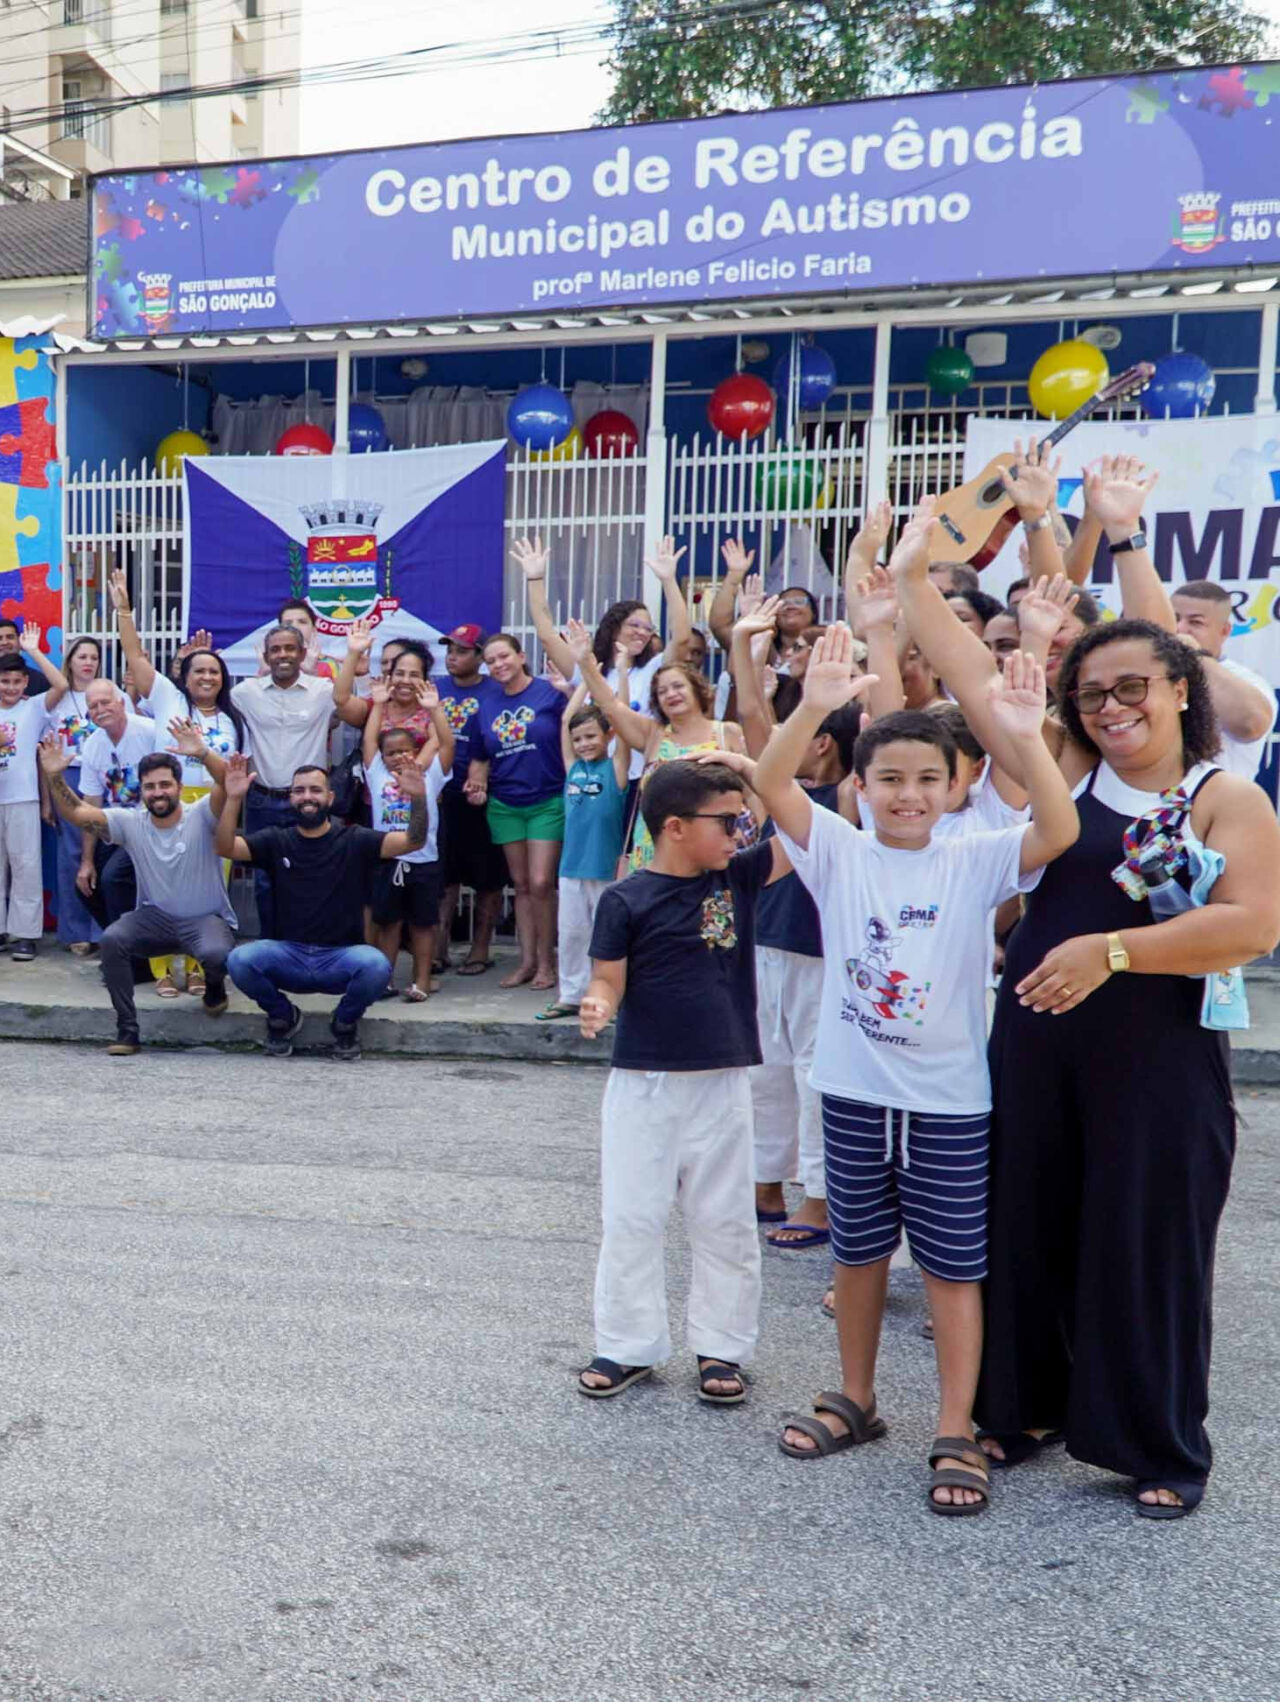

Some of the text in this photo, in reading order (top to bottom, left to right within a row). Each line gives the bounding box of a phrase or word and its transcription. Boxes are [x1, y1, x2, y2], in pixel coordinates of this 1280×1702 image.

[365, 105, 1083, 217] Centro de Referência
[451, 191, 971, 261] Municipal do Autismo
[1231, 217, 1271, 241] SÃO
[179, 275, 277, 293] PREFEITURA MUNICIPAL DE
[600, 267, 700, 292] Marlene
[708, 257, 796, 285] Felicio
[803, 252, 872, 277] Faria
[179, 291, 276, 314] SÃO GONÇALO
[899, 909, 936, 922] CRMA
